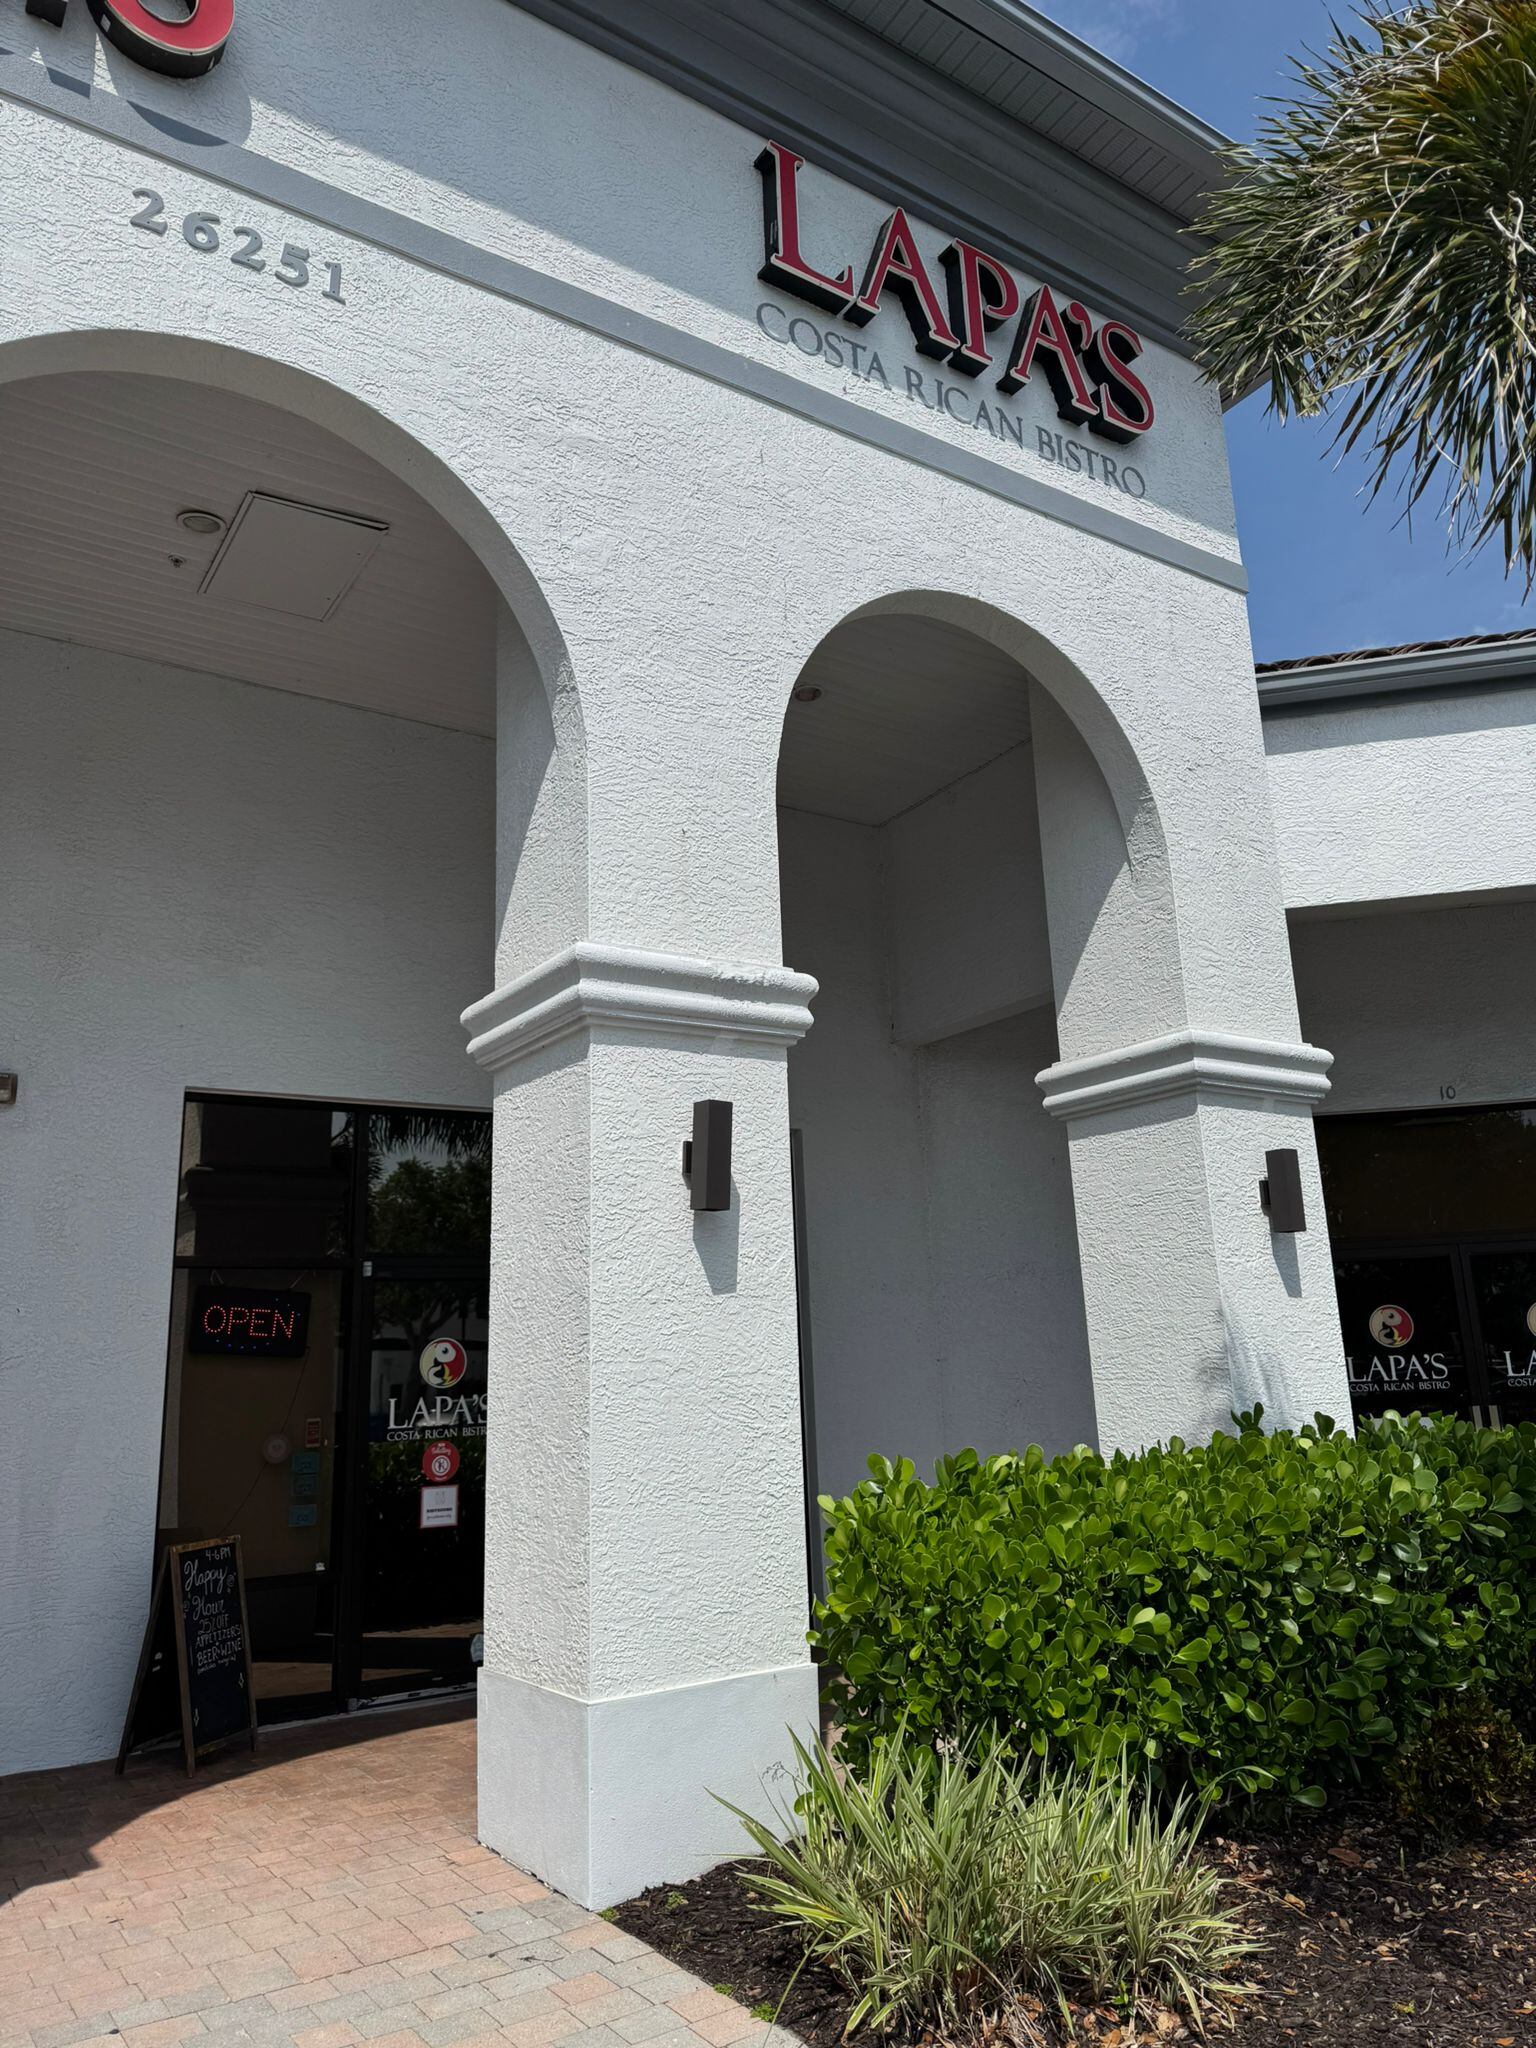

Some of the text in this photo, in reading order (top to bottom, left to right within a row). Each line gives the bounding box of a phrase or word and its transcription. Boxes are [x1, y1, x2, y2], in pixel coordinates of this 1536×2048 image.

[130, 188, 346, 305] 26251
[754, 140, 1156, 444] LAPA'S
[756, 302, 1146, 499] COSTA RICAN BISTRO
[1440, 1086, 1456, 1100] 10
[204, 1305, 295, 1338] OPEN
[1346, 1352, 1450, 1382] LAPA'S
[1349, 1380, 1451, 1393] COSTA RICAN BISTRO
[386, 1425, 487, 1441] COSTA RICAN BISTR
[184, 1559, 228, 1595] Happy
[191, 1595, 226, 1621] Hour
